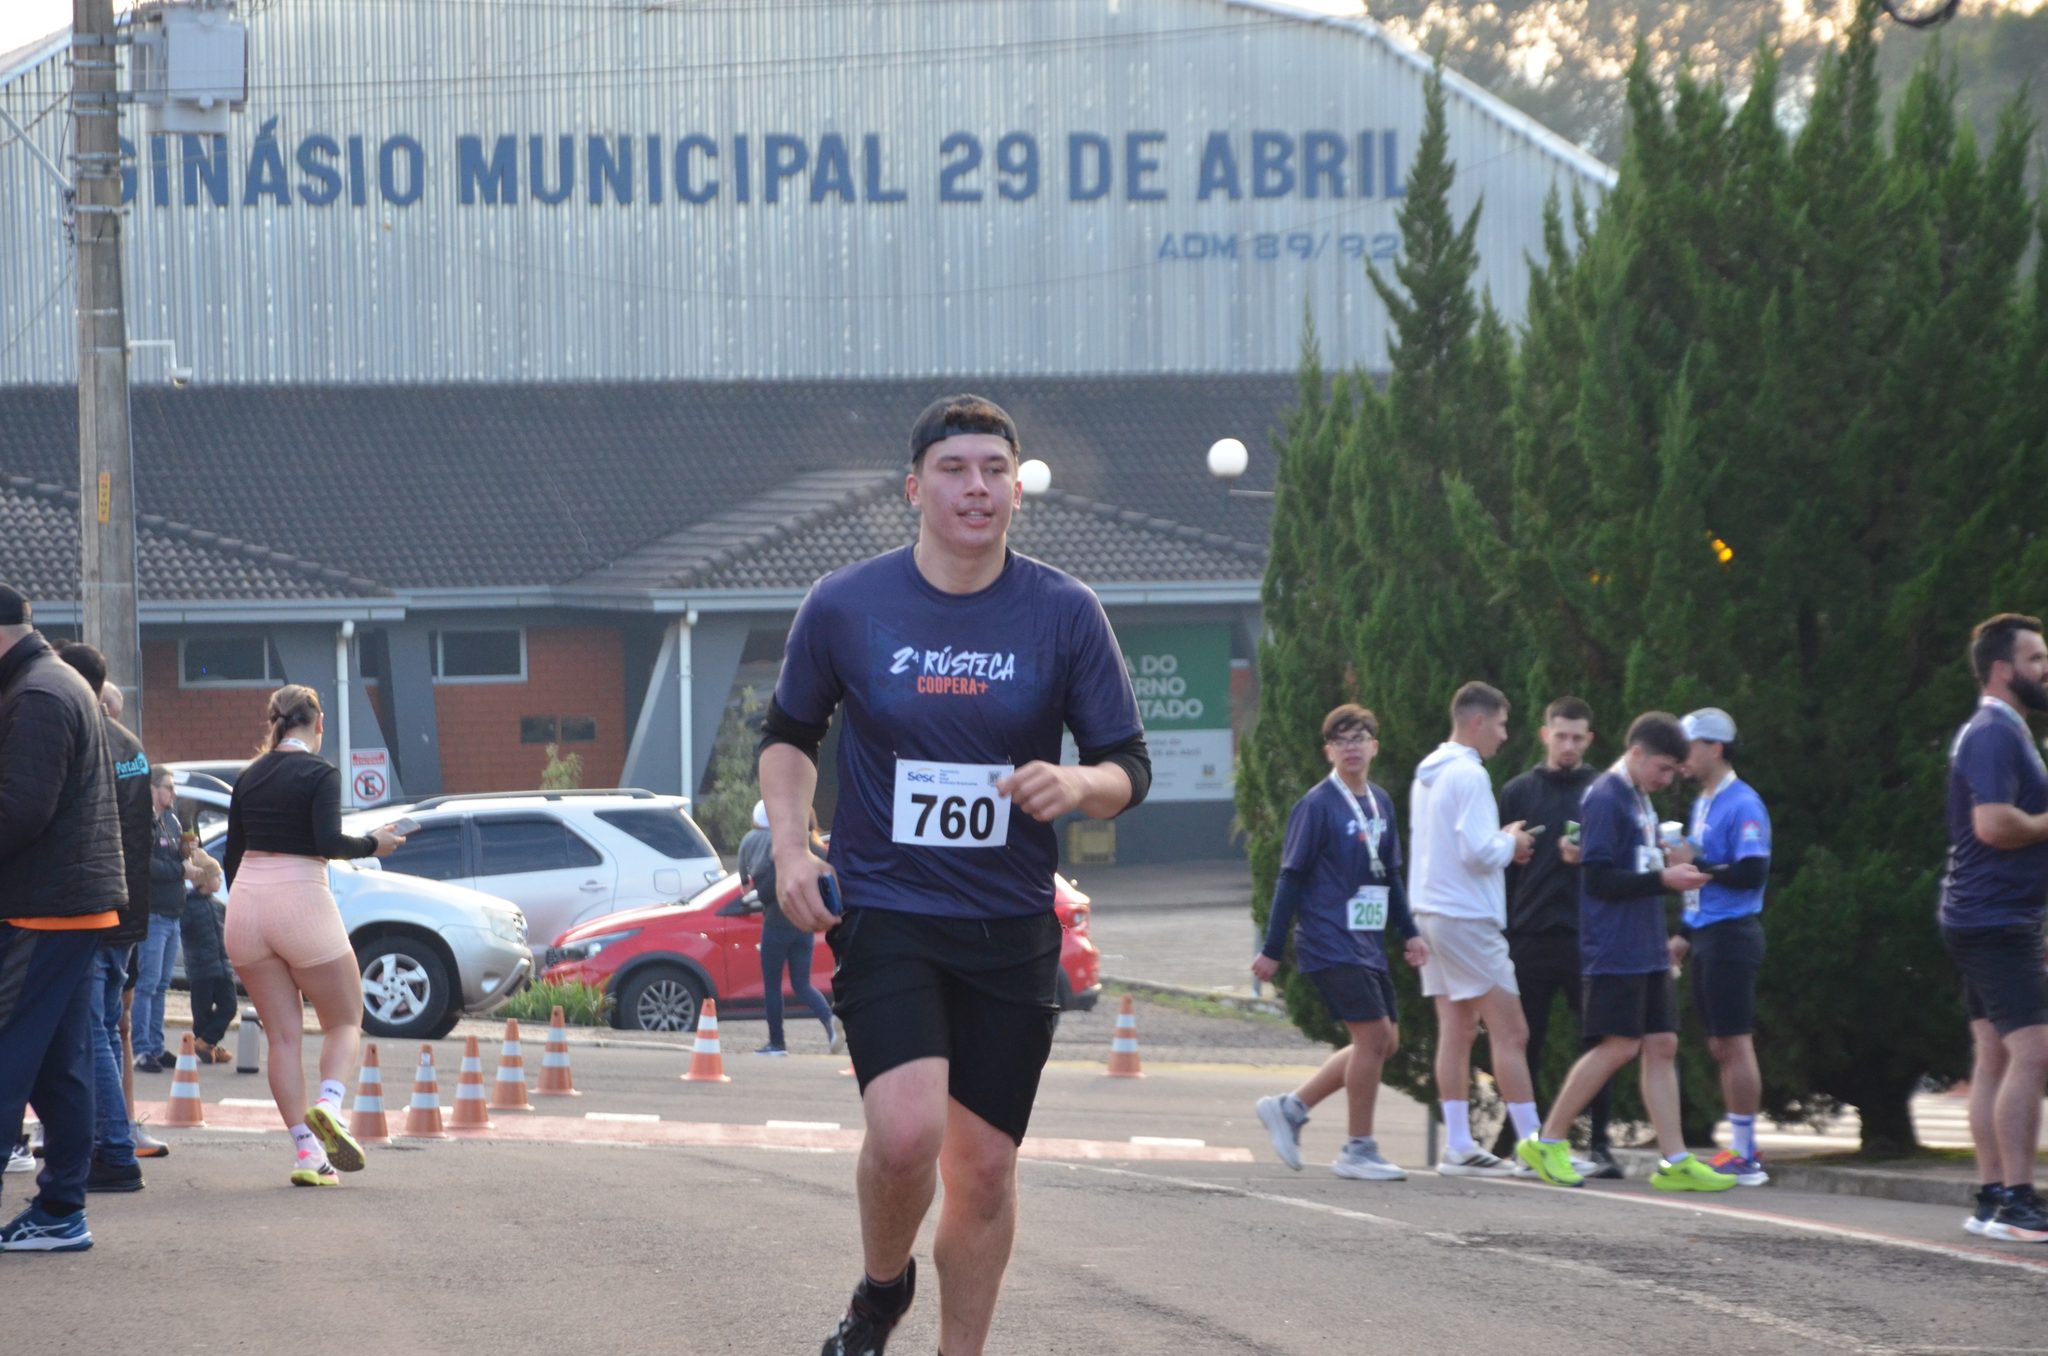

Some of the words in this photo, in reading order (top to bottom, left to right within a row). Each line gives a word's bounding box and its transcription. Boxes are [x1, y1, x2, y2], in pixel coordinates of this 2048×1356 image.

[456, 131, 908, 206] MUNICIPAL
[939, 130, 1040, 203] 29
[1067, 129, 1168, 202] DE
[1196, 127, 1409, 201] ABRIL
[1157, 231, 1239, 260] ADM
[923, 645, 1015, 681] RÚSTICA
[1141, 654, 1178, 676] DO
[917, 676, 989, 695] COOPERA+
[1133, 677, 1187, 698] RNO
[1139, 698, 1204, 720] TADO
[911, 793, 995, 841] 760
[1354, 902, 1384, 926] 205
